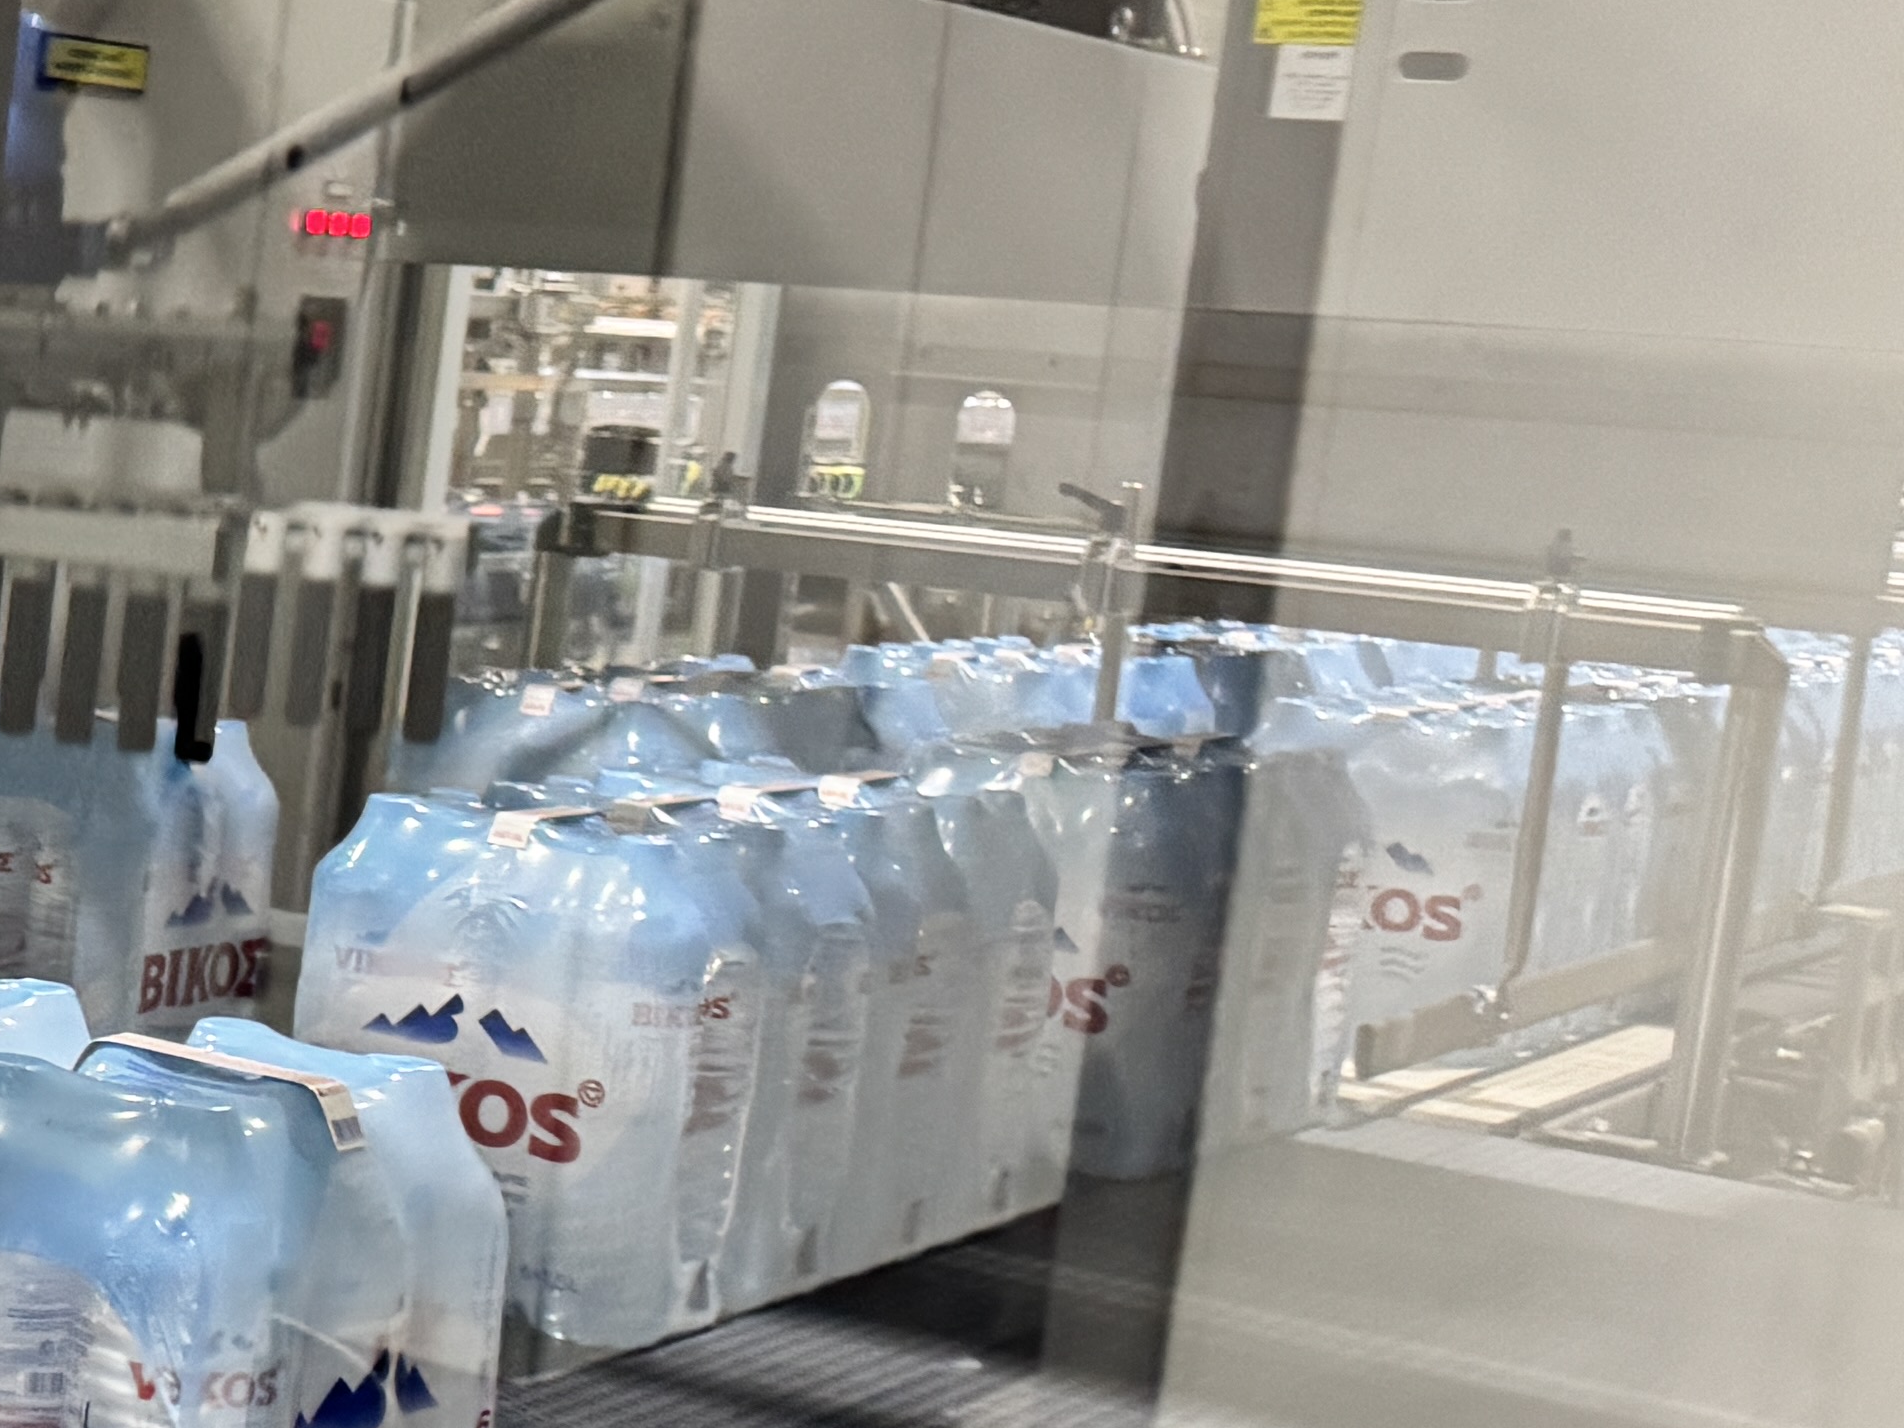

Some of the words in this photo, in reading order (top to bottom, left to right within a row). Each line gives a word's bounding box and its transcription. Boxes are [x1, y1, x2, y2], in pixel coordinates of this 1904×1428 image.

[1362, 885, 1462, 942] OS
[137, 936, 271, 1013] ΒΙΚΟΣ
[448, 1071, 582, 1164] OS
